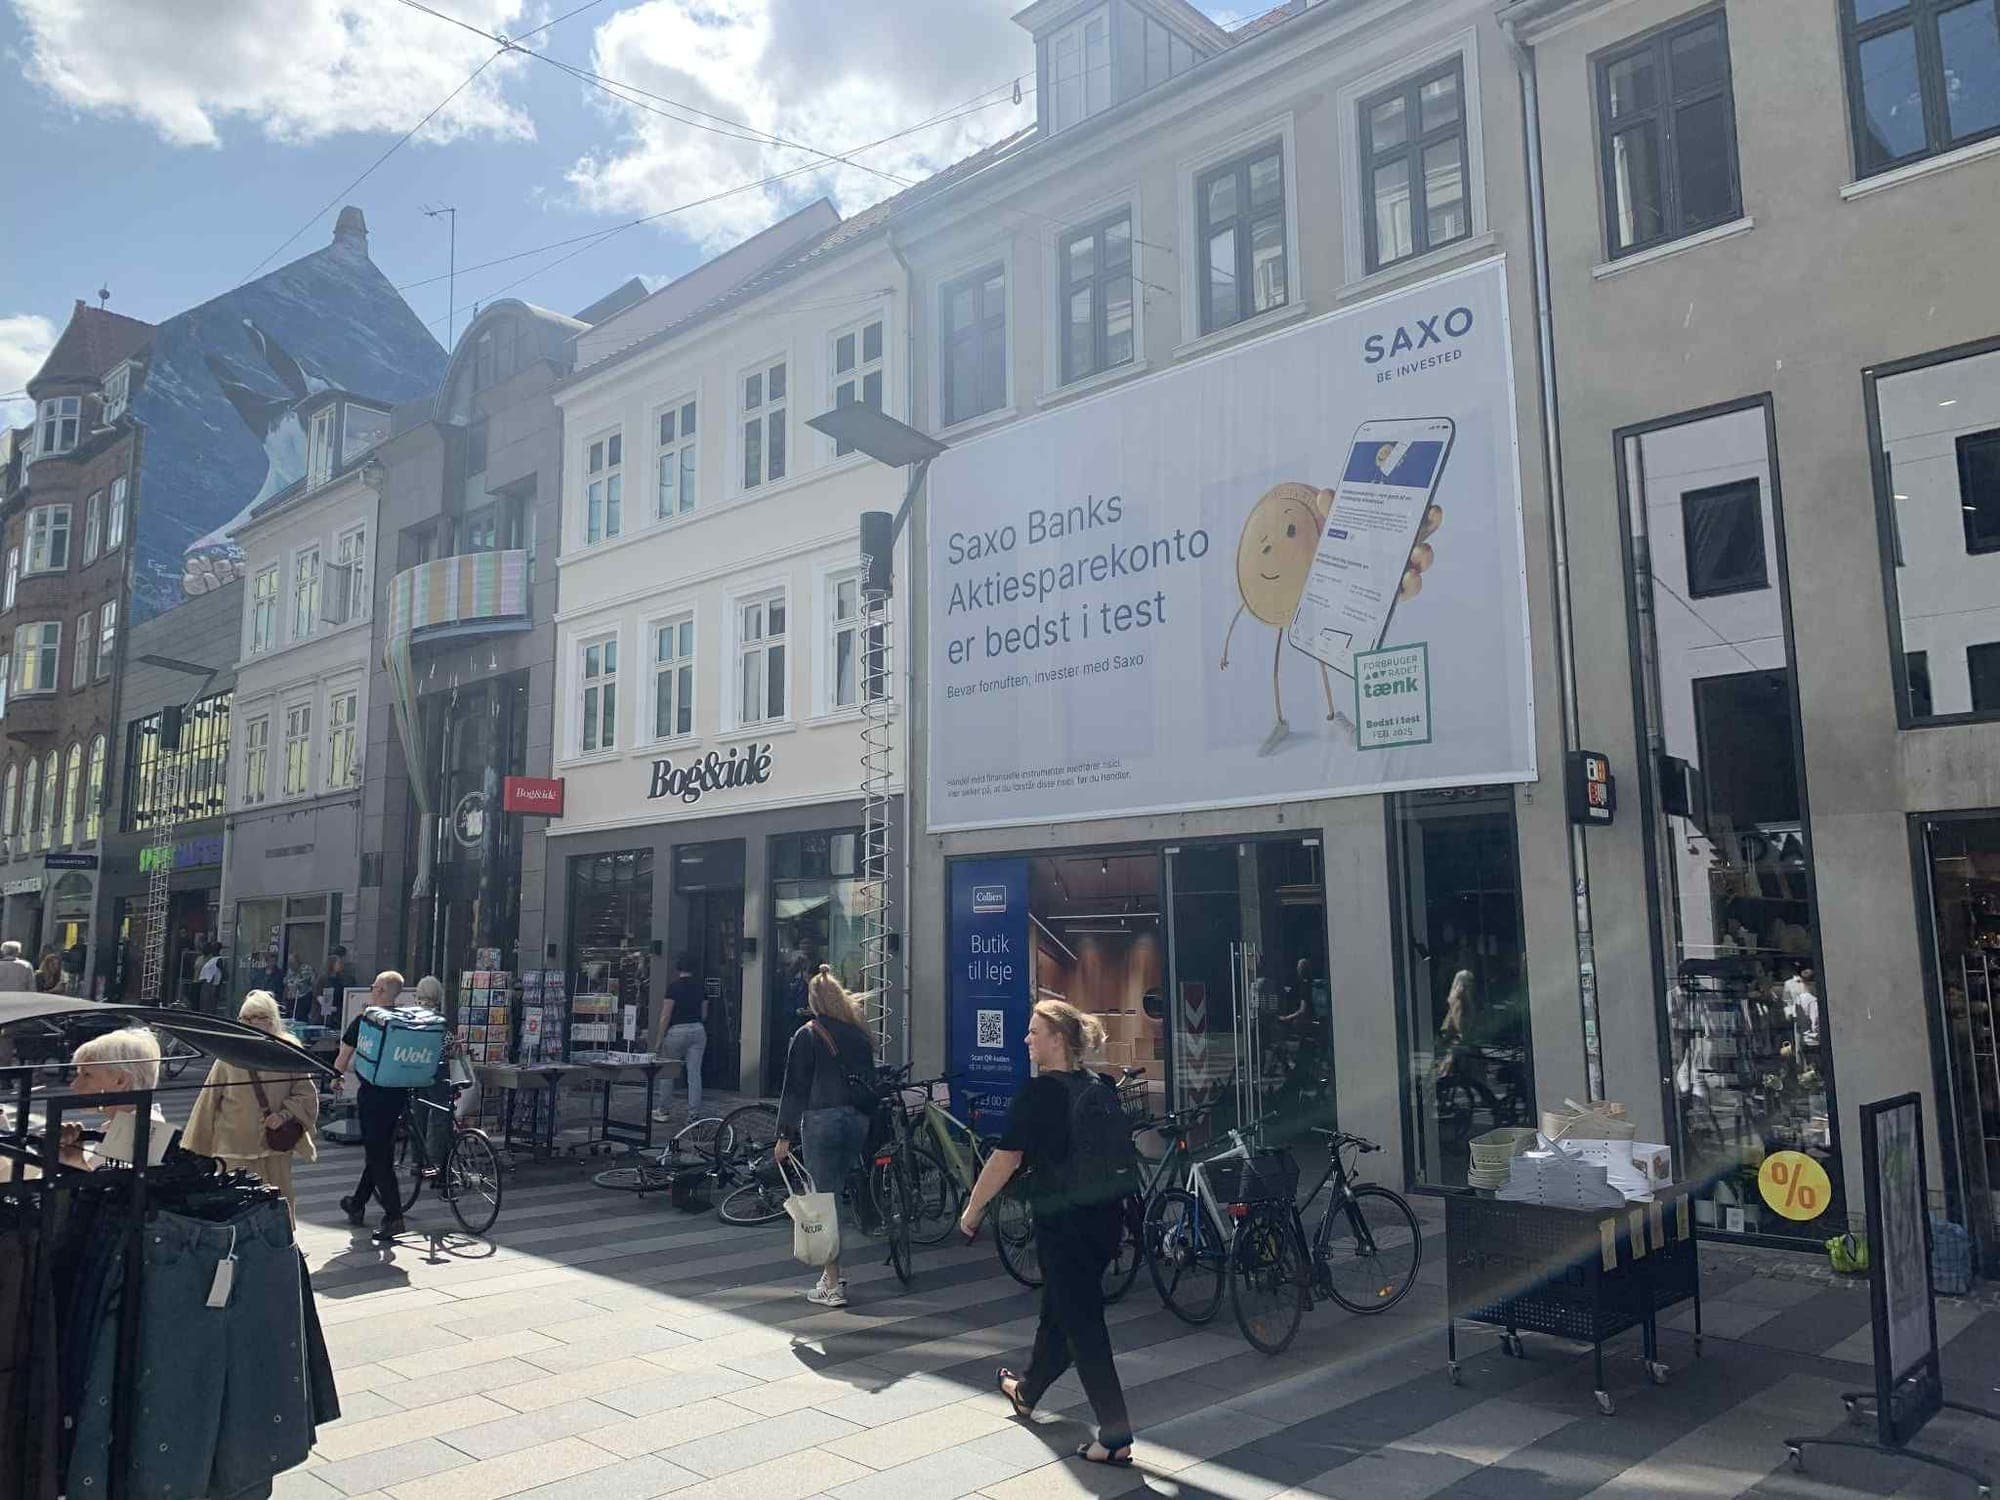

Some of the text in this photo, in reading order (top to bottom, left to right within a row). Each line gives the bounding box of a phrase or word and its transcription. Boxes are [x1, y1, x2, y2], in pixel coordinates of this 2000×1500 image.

[1364, 306, 1474, 365] SAXO
[1376, 349, 1463, 384] BE INVESTED
[947, 495, 1123, 565] Saxo Banks
[948, 528, 1209, 615] Aktiesparekonto
[948, 591, 1167, 664] er bedst i test
[947, 653, 1144, 699] Bevar fornuften, invester med Saxo
[1363, 655, 1418, 671] FORBRUGER
[1364, 677, 1419, 698] tænk
[1366, 719, 1393, 729] Bedst
[976, 891, 1003, 903] Colliers
[971, 934, 1010, 954] Butik
[968, 960, 1013, 986] til leje
[394, 1046, 434, 1064] Wolt
[1771, 1161, 1817, 1210] %
